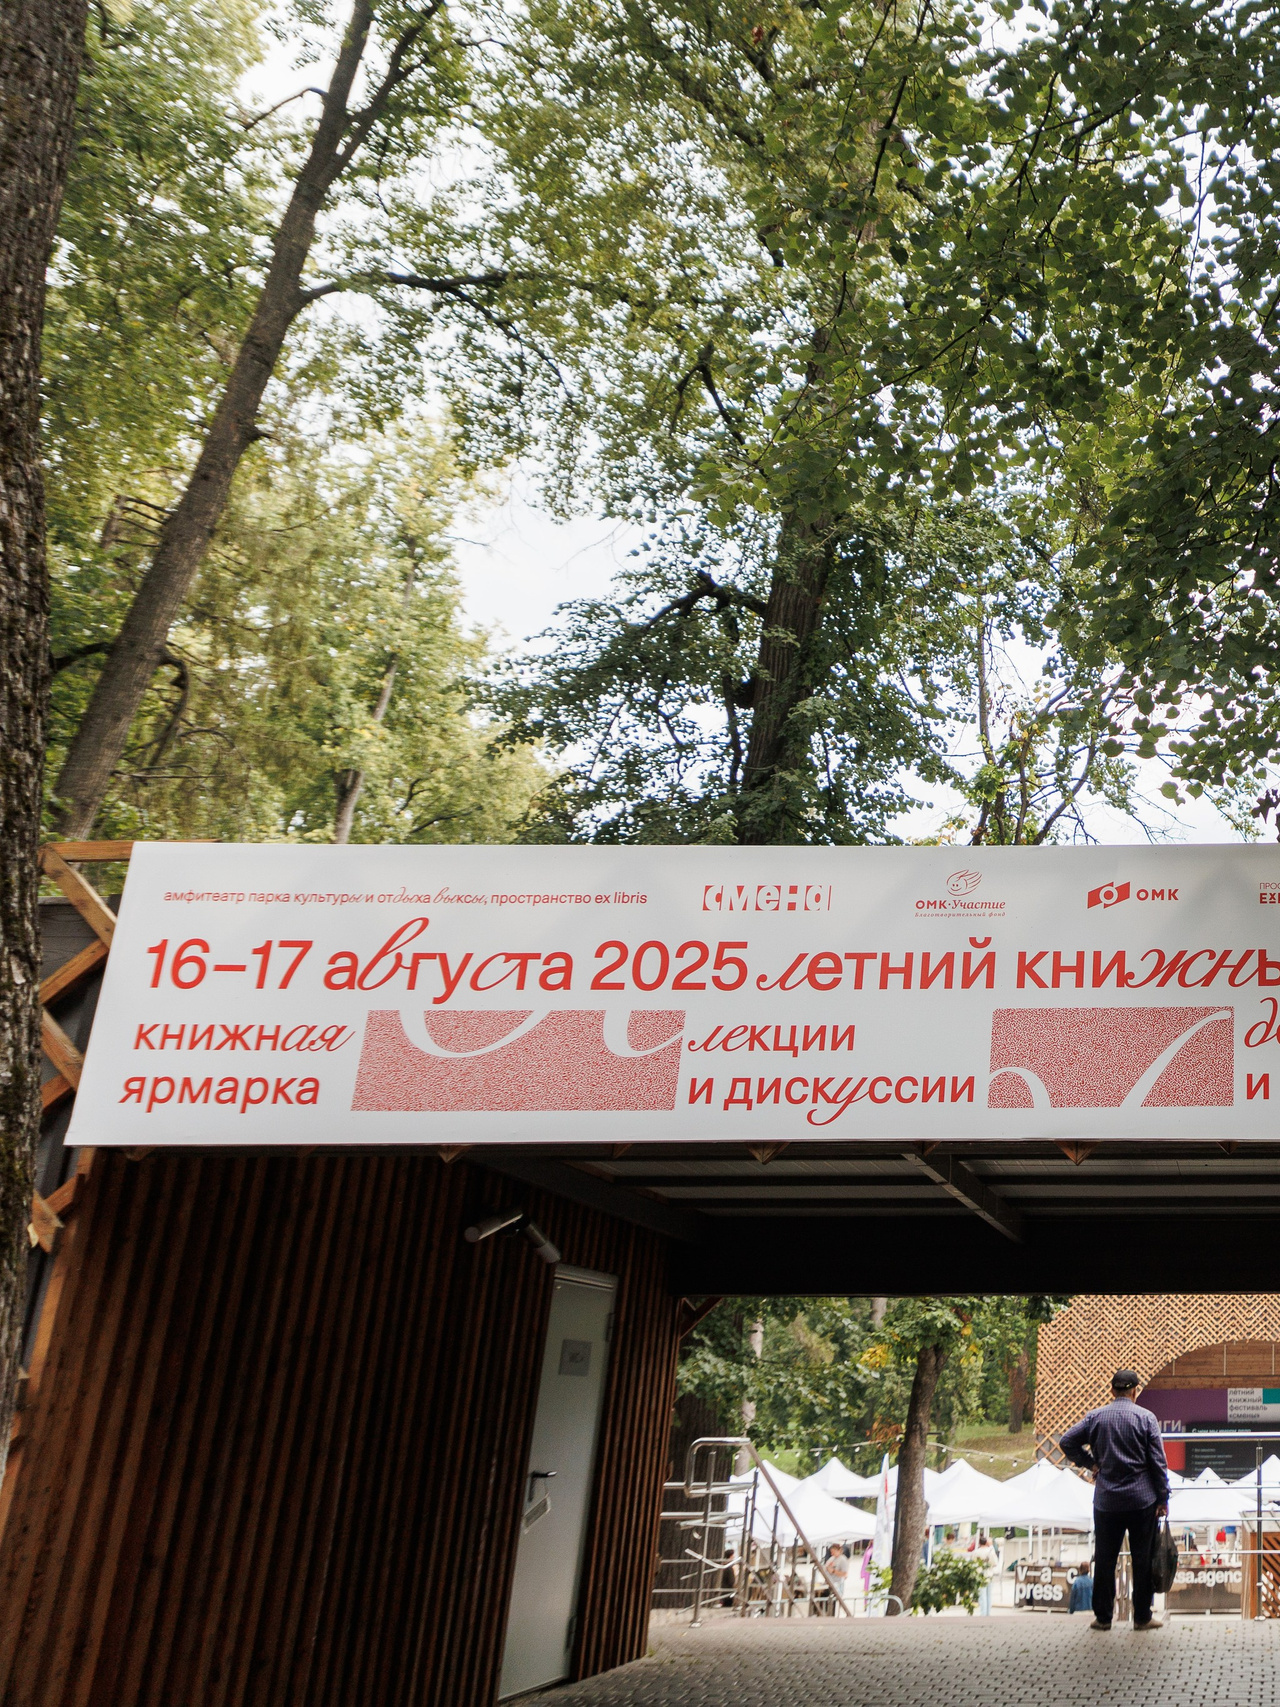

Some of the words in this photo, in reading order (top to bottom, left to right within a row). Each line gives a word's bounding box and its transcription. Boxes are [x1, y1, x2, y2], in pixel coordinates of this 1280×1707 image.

[162, 889, 246, 905] амфитеатр
[248, 892, 291, 905] парка
[293, 892, 364, 906] культуры
[364, 893, 375, 904] и
[377, 886, 432, 905] отдыха
[432, 886, 488, 906] выксы,
[490, 893, 592, 907] пространство
[594, 893, 611, 905] ex
[613, 891, 648, 905] libris
[1136, 888, 1180, 902] ОМК
[322, 917, 574, 1005] августа
[590, 940, 749, 992] 2025
[756, 936, 996, 992] летний
[133, 1023, 355, 1053] книжная
[687, 1024, 856, 1058] лекции
[118, 1075, 321, 1115] ярмарка
[688, 1077, 714, 1104] и
[723, 1076, 976, 1126] дискуссии
[1245, 1072, 1270, 1101] и
[1014, 1583, 1063, 1604] press
